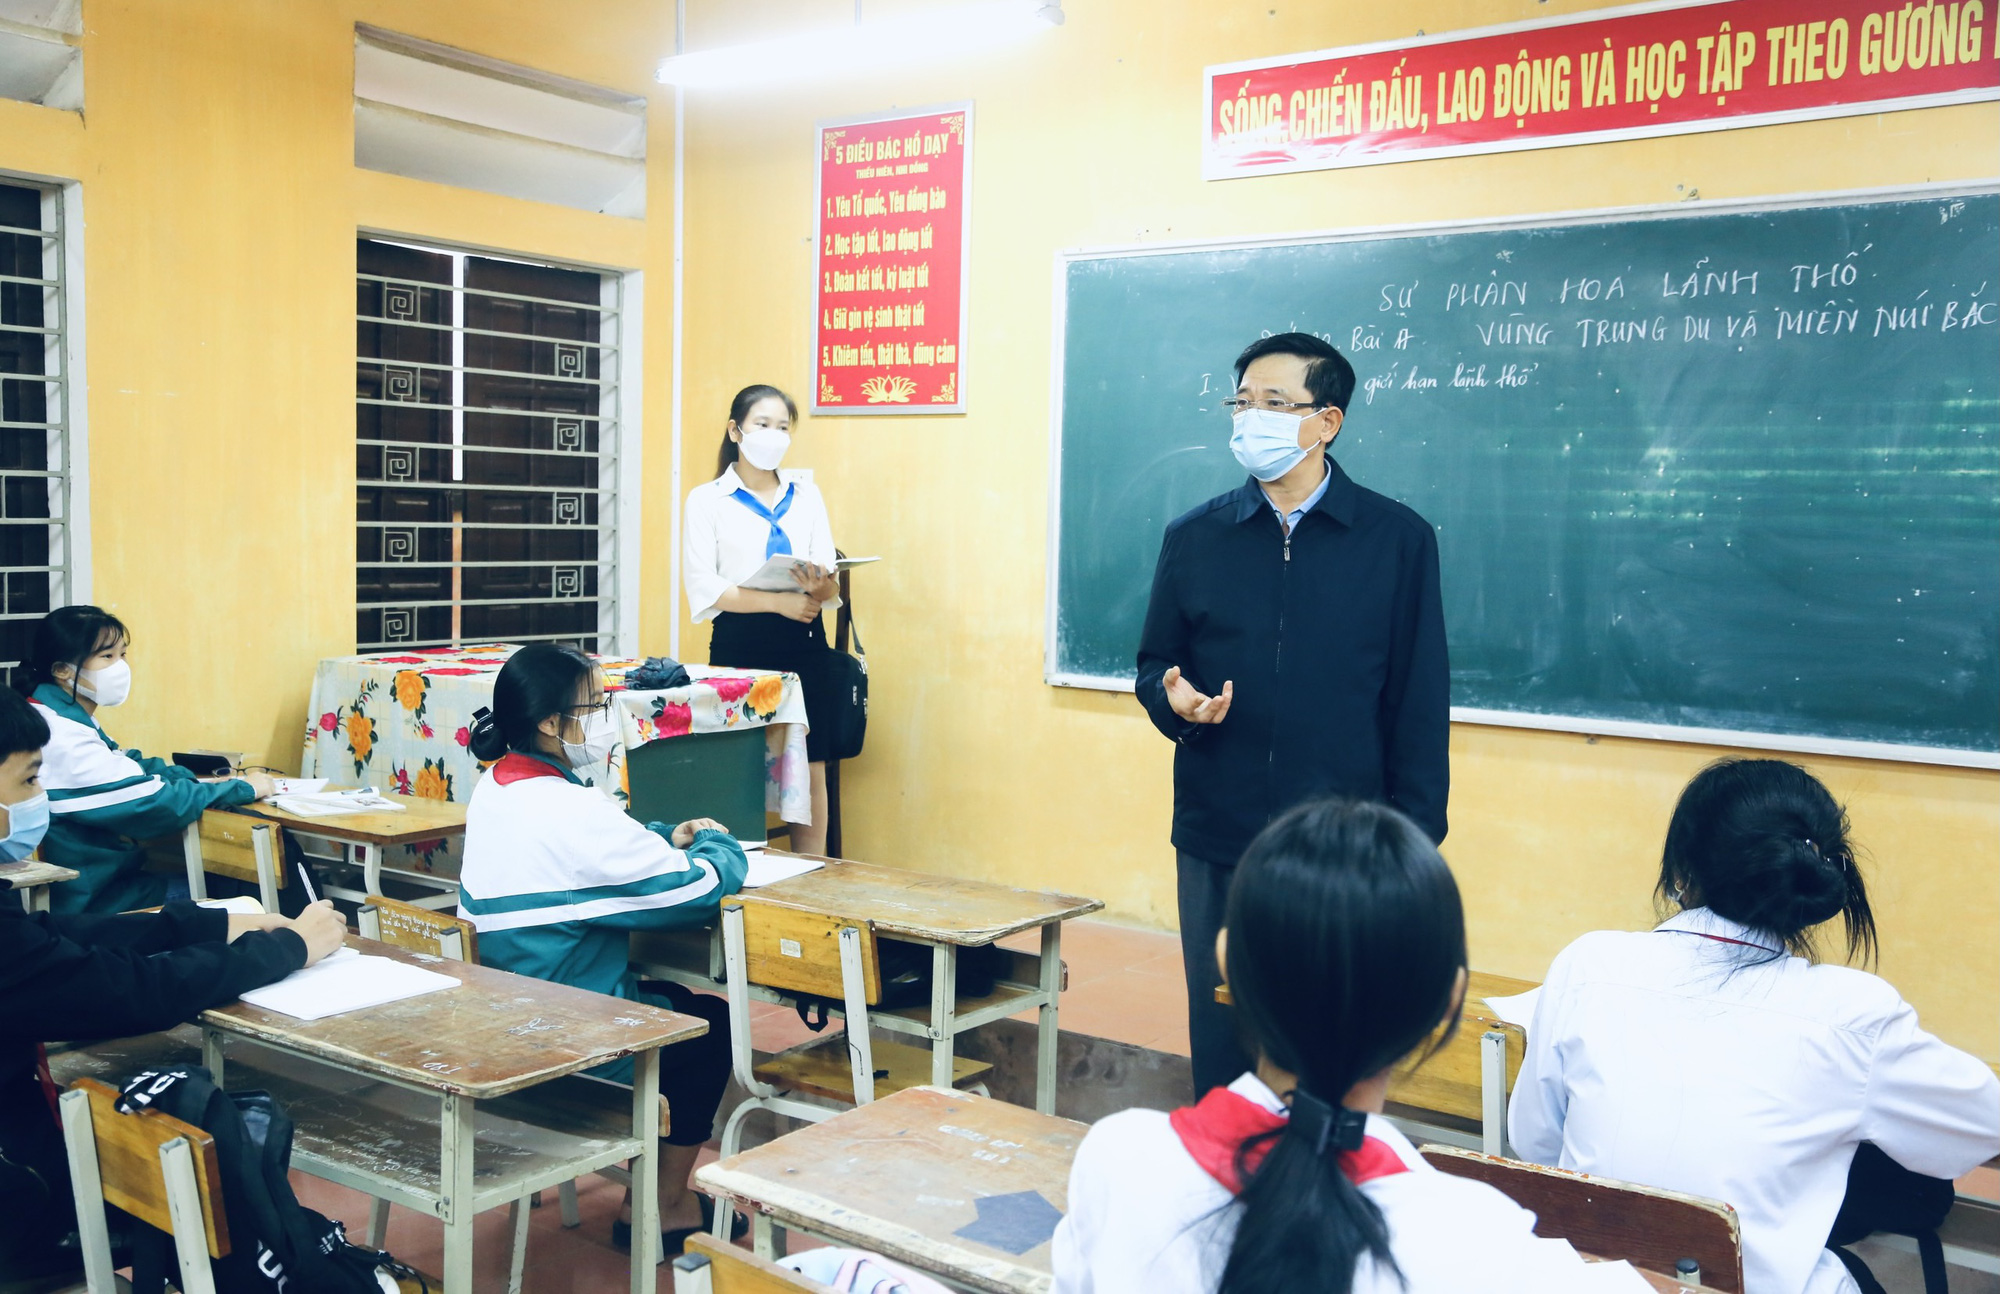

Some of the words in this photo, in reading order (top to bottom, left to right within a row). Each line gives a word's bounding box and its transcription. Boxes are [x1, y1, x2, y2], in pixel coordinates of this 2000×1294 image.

[1290, 68, 1363, 141] CHIẾN
[1369, 58, 1429, 134] ĐẤU,
[1437, 66, 1486, 125] LAO
[1493, 49, 1571, 128] ĐỘNG
[1581, 38, 1616, 109] VÀ
[1625, 40, 1687, 114] HỌC
[1697, 21, 1756, 106] TẬP
[1766, 18, 1849, 87] THEO
[1859, 0, 1984, 76] GƯƠNG
[835, 145, 844, 165] 5
[846, 137, 874, 164] ĐIỀU
[876, 136, 901, 161] BÁC
[904, 130, 921, 157] HỒ
[924, 133, 949, 159] DẠY
[826, 198, 834, 218] 1.
[836, 195, 850, 218] Yêu
[852, 189, 863, 216] Tổ
[864, 189, 887, 218] quốc,
[889, 190, 905, 213] Yêu
[907, 185, 928, 213] đồng
[930, 186, 946, 210] bào
[825, 234, 833, 256] 2.
[834, 233, 850, 259] Học
[852, 231, 866, 259] tập
[867, 228, 881, 254] tốt,
[882, 230, 896, 252] lao
[898, 228, 919, 255] động
[921, 223, 933, 249] tốt
[824, 272, 832, 293] 3.
[834, 269, 854, 292] Đoàn
[856, 265, 870, 291] kết
[871, 265, 885, 292] tốt,
[899, 265, 915, 293] luật
[917, 262, 929, 288] tốt
[1379, 280, 1419, 318] SỰ
[1446, 269, 1527, 311] PHÂN
[1663, 256, 1758, 299] LÃNH
[823, 309, 832, 330] 4.
[833, 307, 847, 329] Giữ
[848, 307, 862, 332] gìn
[864, 306, 873, 333] vệ
[875, 306, 893, 328] sinh
[895, 304, 911, 332] thật
[913, 300, 925, 326] tốt
[1576, 315, 1668, 348] TRUNG
[1684, 315, 1710, 343] DU
[1777, 299, 1859, 340] MIỀN
[1873, 289, 1934, 338] NÚI
[1941, 281, 1997, 332] BẮC
[823, 346, 831, 367] 5.
[832, 345, 858, 367] Khiêm
[860, 340, 876, 368] tốn,
[878, 342, 894, 370] thật
[913, 342, 935, 366] dũng
[936, 338, 956, 364] cảm
[1364, 362, 1398, 405] giới
[1401, 365, 1438, 395] hạn
